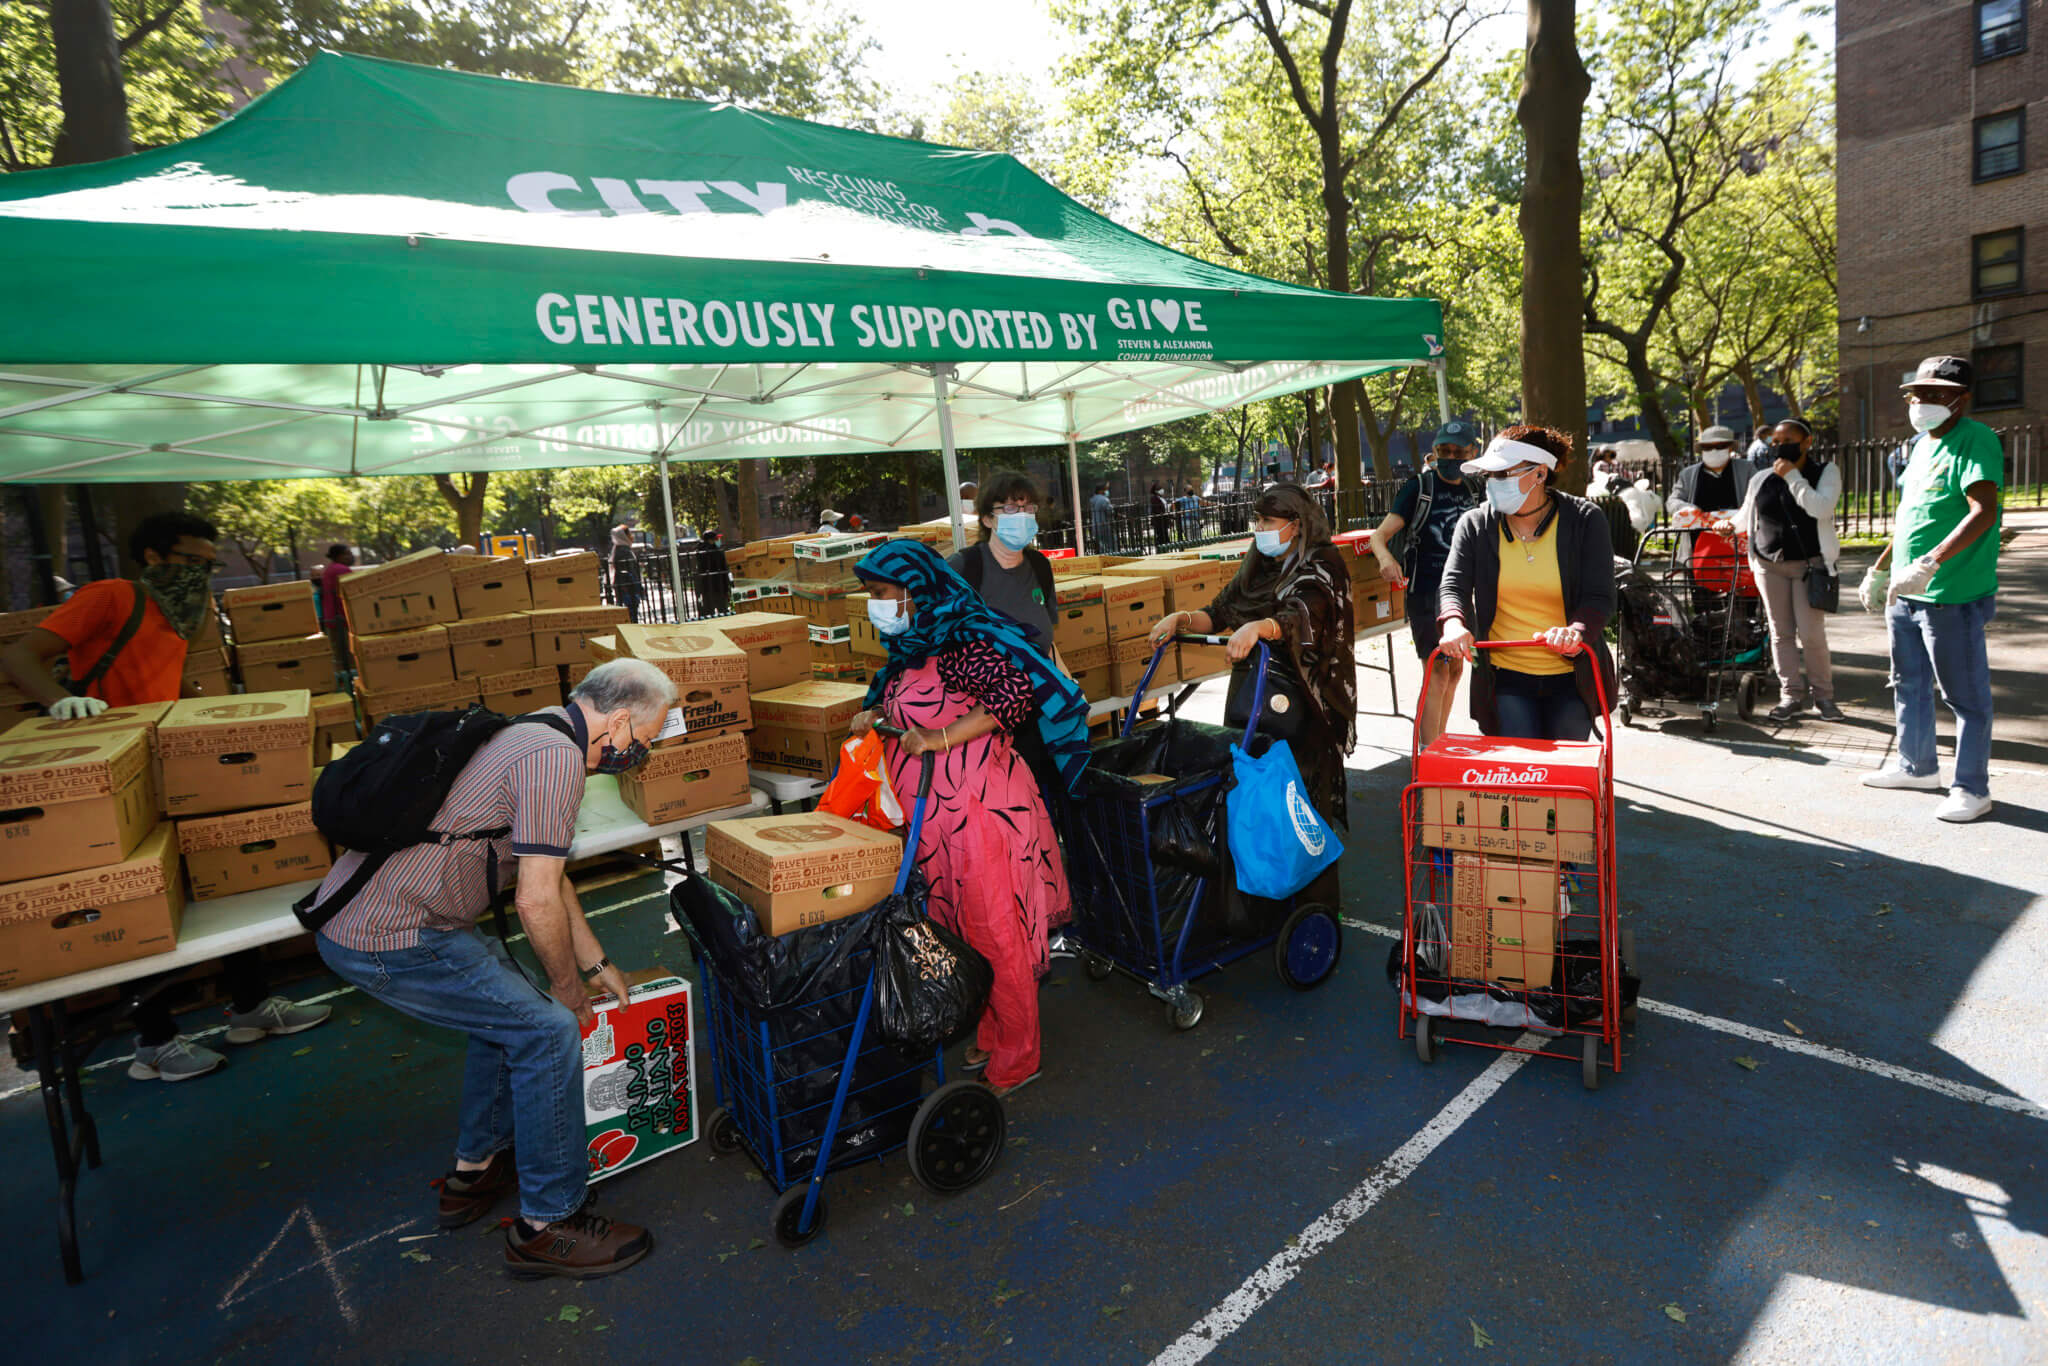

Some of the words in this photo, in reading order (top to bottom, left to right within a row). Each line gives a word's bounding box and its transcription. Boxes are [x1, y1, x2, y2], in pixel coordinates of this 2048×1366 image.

[506, 171, 787, 218] CITY
[786, 165, 906, 202] RESCUING
[824, 187, 895, 214] FOOD
[896, 201, 948, 223] FOR
[535, 292, 835, 347] GENEROUSLY
[850, 304, 1053, 349] SUPPORTED
[1059, 312, 1098, 350] BY
[1117, 339, 1151, 349] STEVEN
[1153, 340, 1161, 349] &
[1163, 340, 1213, 350] ALEXANDRA
[1117, 352, 1150, 361] COHEN
[1154, 353, 1213, 361] FOUNDATION
[683, 700, 722, 718] Fresh
[685, 711, 738, 730] matoes
[56, 763, 108, 777] LIPMAN
[1462, 765, 1549, 784] Crimson
[15, 791, 65, 803] VELVET
[1484, 792, 1500, 800] best
[1501, 793, 1511, 803] of
[772, 858, 806, 870] VELVET
[867, 844, 900, 857] LIPMAN
[812, 862, 849, 876] LIPMAN
[868, 855, 900, 867] VELVET
[113, 863, 163, 881] LIPMAN
[783, 879, 820, 893] LIPMAN
[840, 869, 872, 881] VELVET
[32, 890, 86, 908] LIPMAN
[117, 876, 166, 892] VELVET
[73, 894, 122, 910] VELVET
[667, 1002, 689, 1082] TOMATOES
[625, 1043, 649, 1131] PRIMO
[647, 1018, 671, 1134] ITALIANO
[672, 1078, 689, 1135] ROMA
